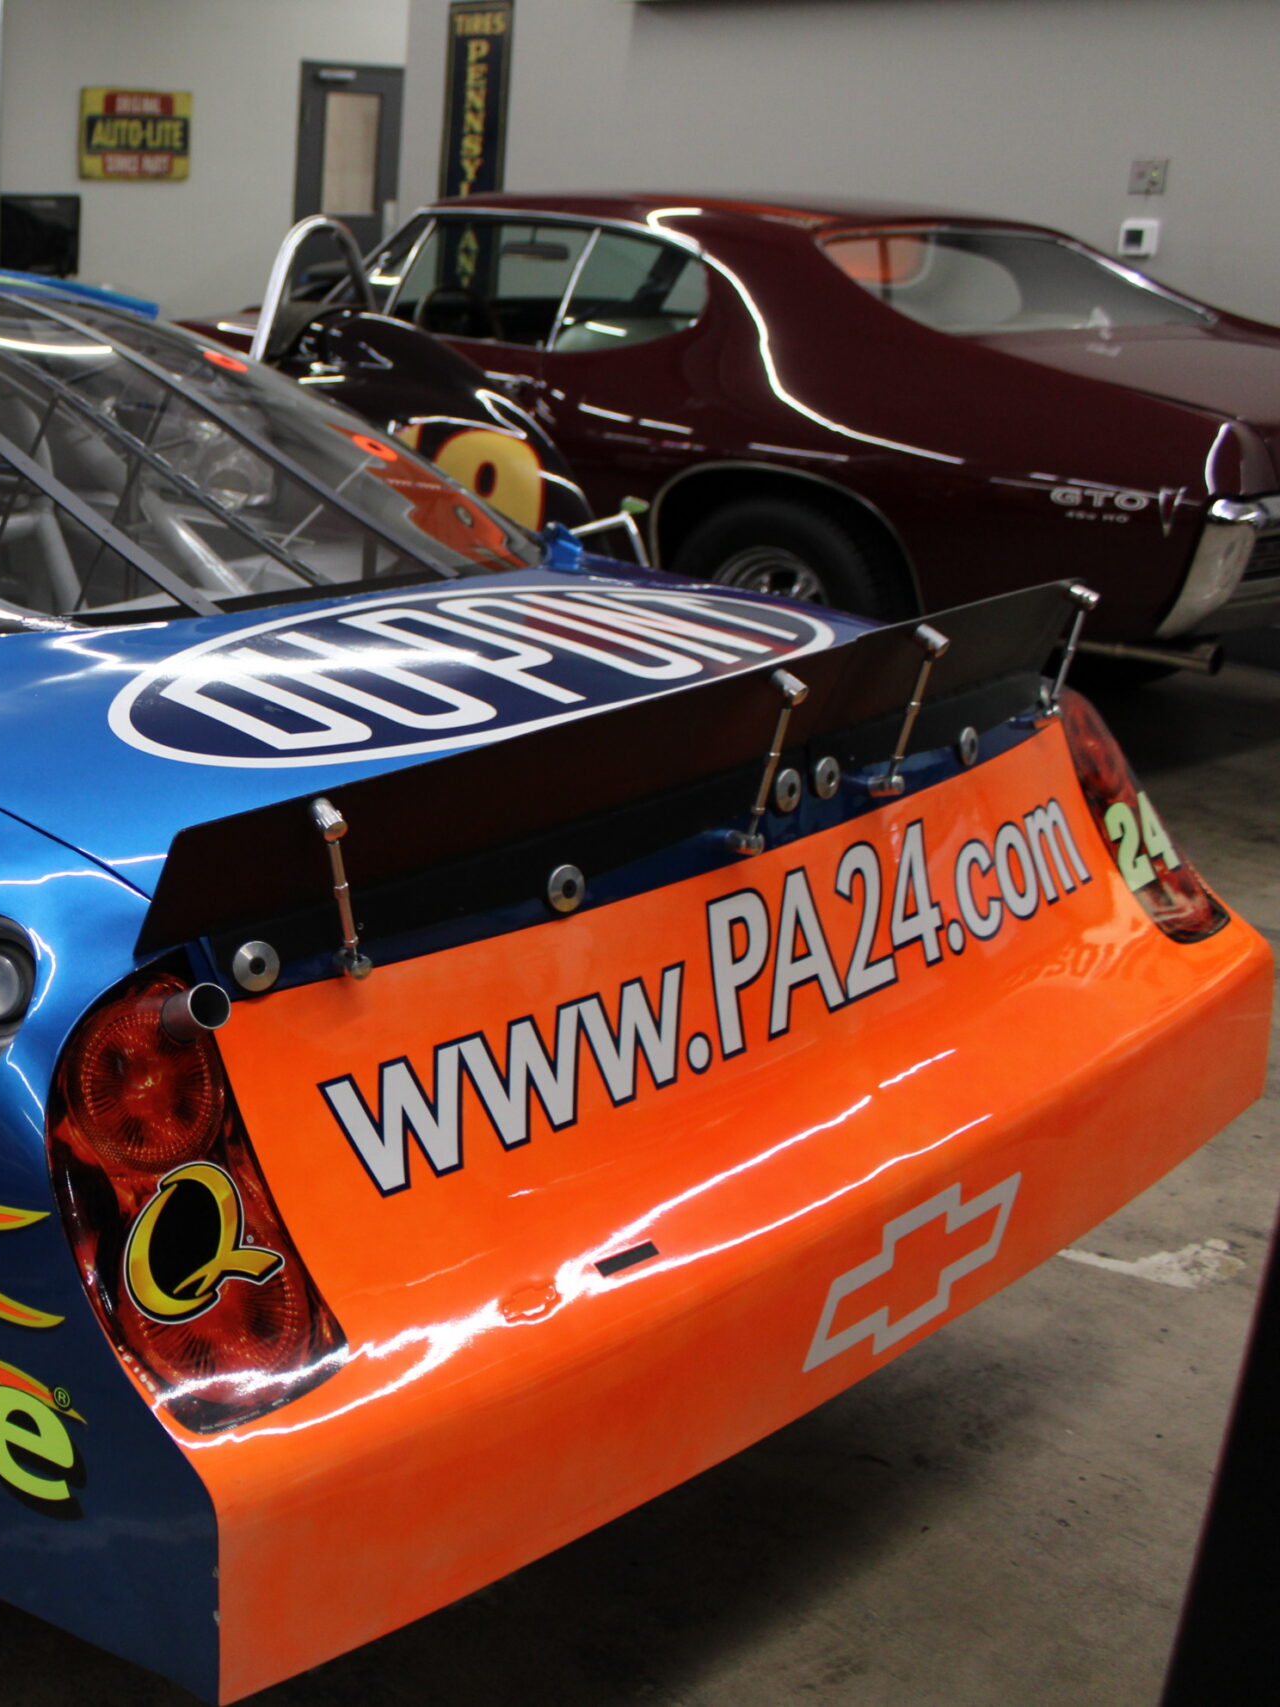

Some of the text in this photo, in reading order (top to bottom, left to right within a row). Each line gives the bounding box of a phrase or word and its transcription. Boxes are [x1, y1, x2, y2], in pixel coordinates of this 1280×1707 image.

[455, 11, 507, 36] TIRES
[91, 117, 184, 150] AUTO-LITE
[1049, 486, 1150, 513] GTO
[160, 592, 798, 752] DUPONT
[1104, 791, 1182, 893] 24
[317, 797, 1093, 1198] www.PA24.com
[124, 1161, 285, 1324] Q
